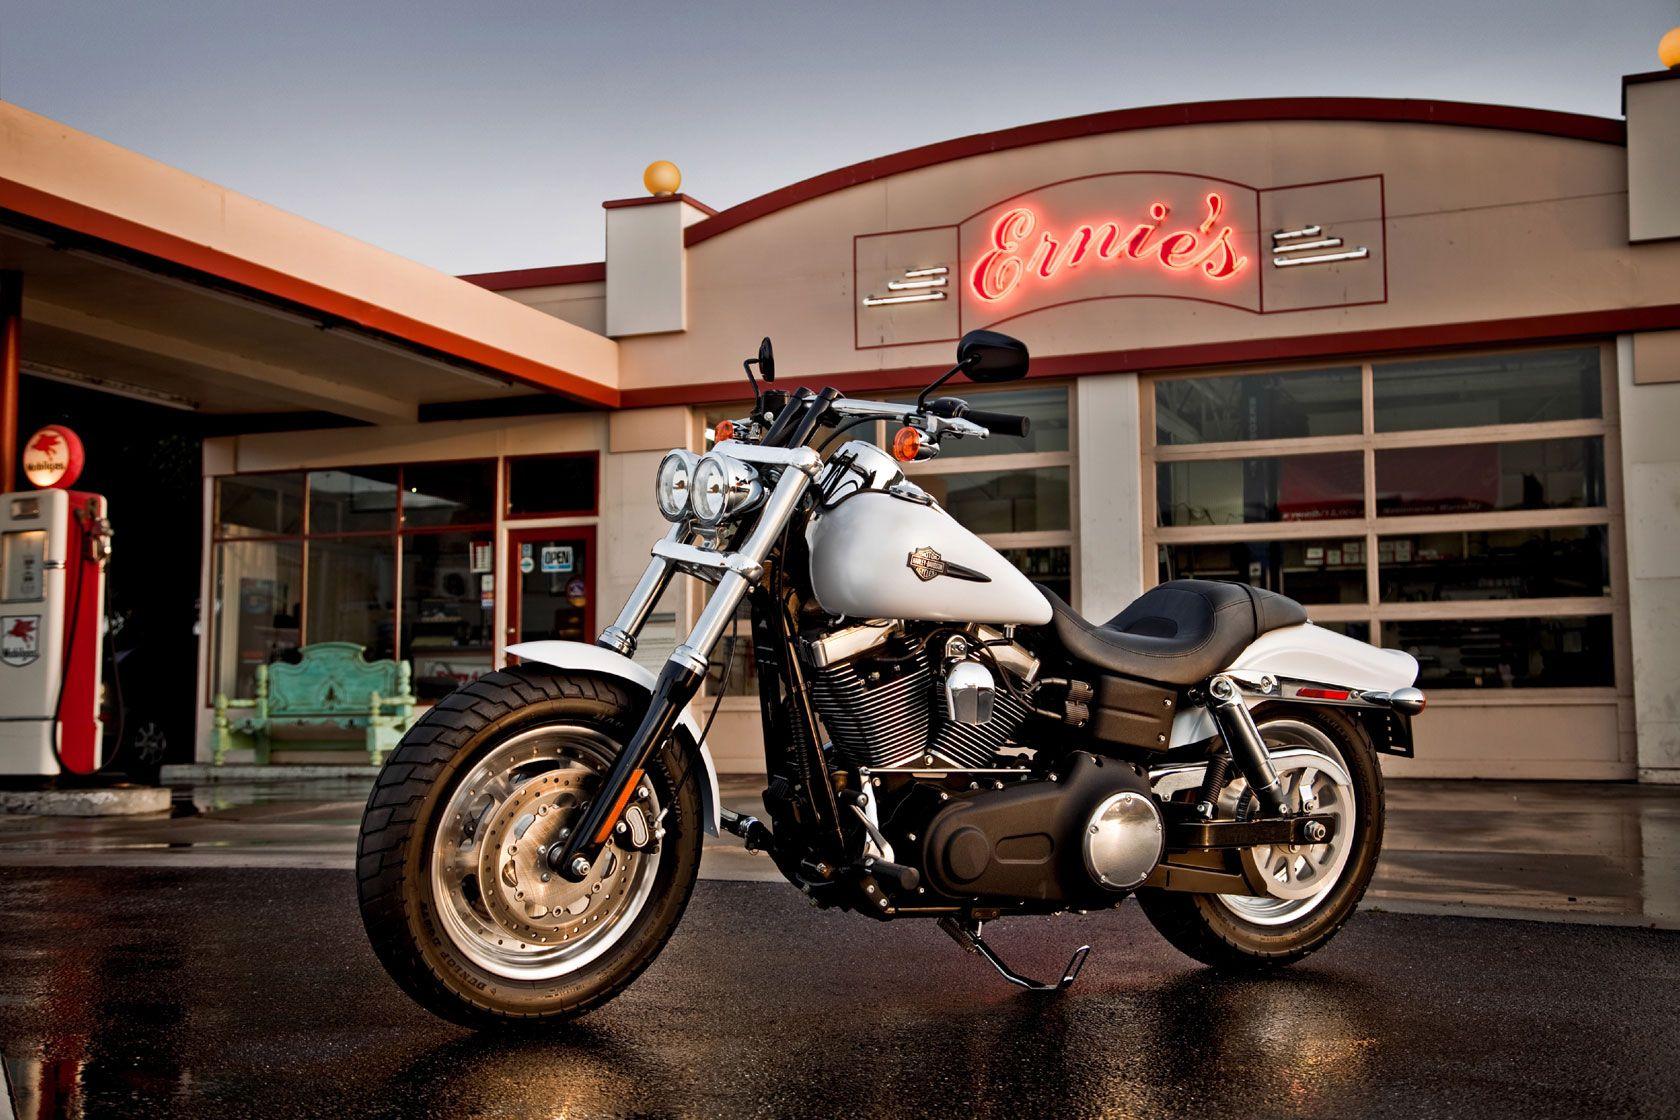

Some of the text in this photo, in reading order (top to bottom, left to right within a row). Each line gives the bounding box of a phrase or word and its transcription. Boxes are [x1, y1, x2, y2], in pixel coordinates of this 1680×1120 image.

[968, 191, 1249, 304] Ernie's
[544, 550, 569, 564] OPEN
[440, 951, 488, 991] DUNLOP
